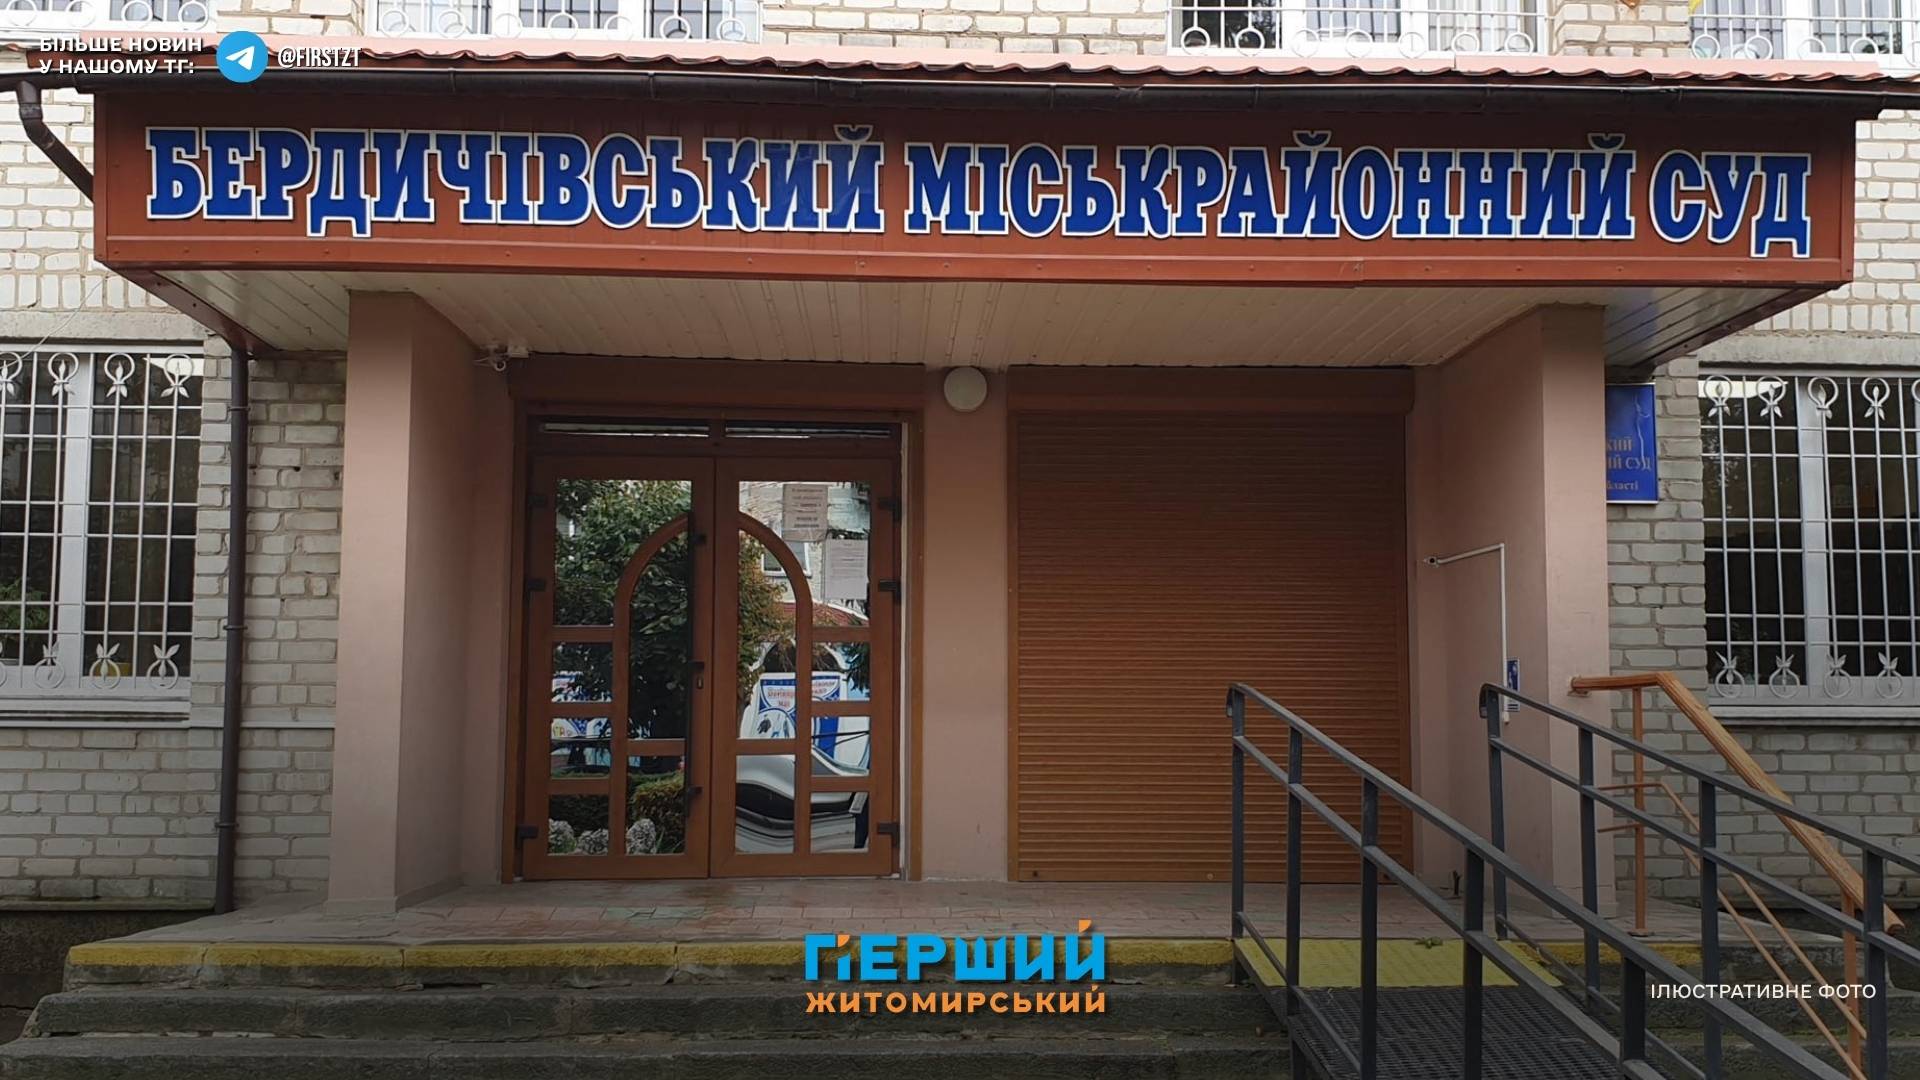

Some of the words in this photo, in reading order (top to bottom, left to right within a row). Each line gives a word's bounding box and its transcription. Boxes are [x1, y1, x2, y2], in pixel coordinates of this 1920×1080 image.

[145, 124, 885, 237] БЕРДИЧІВСЬКИЙ
[903, 130, 1637, 241] МІСЬКРАЙОННИЙ
[1649, 149, 1812, 259] СУД
